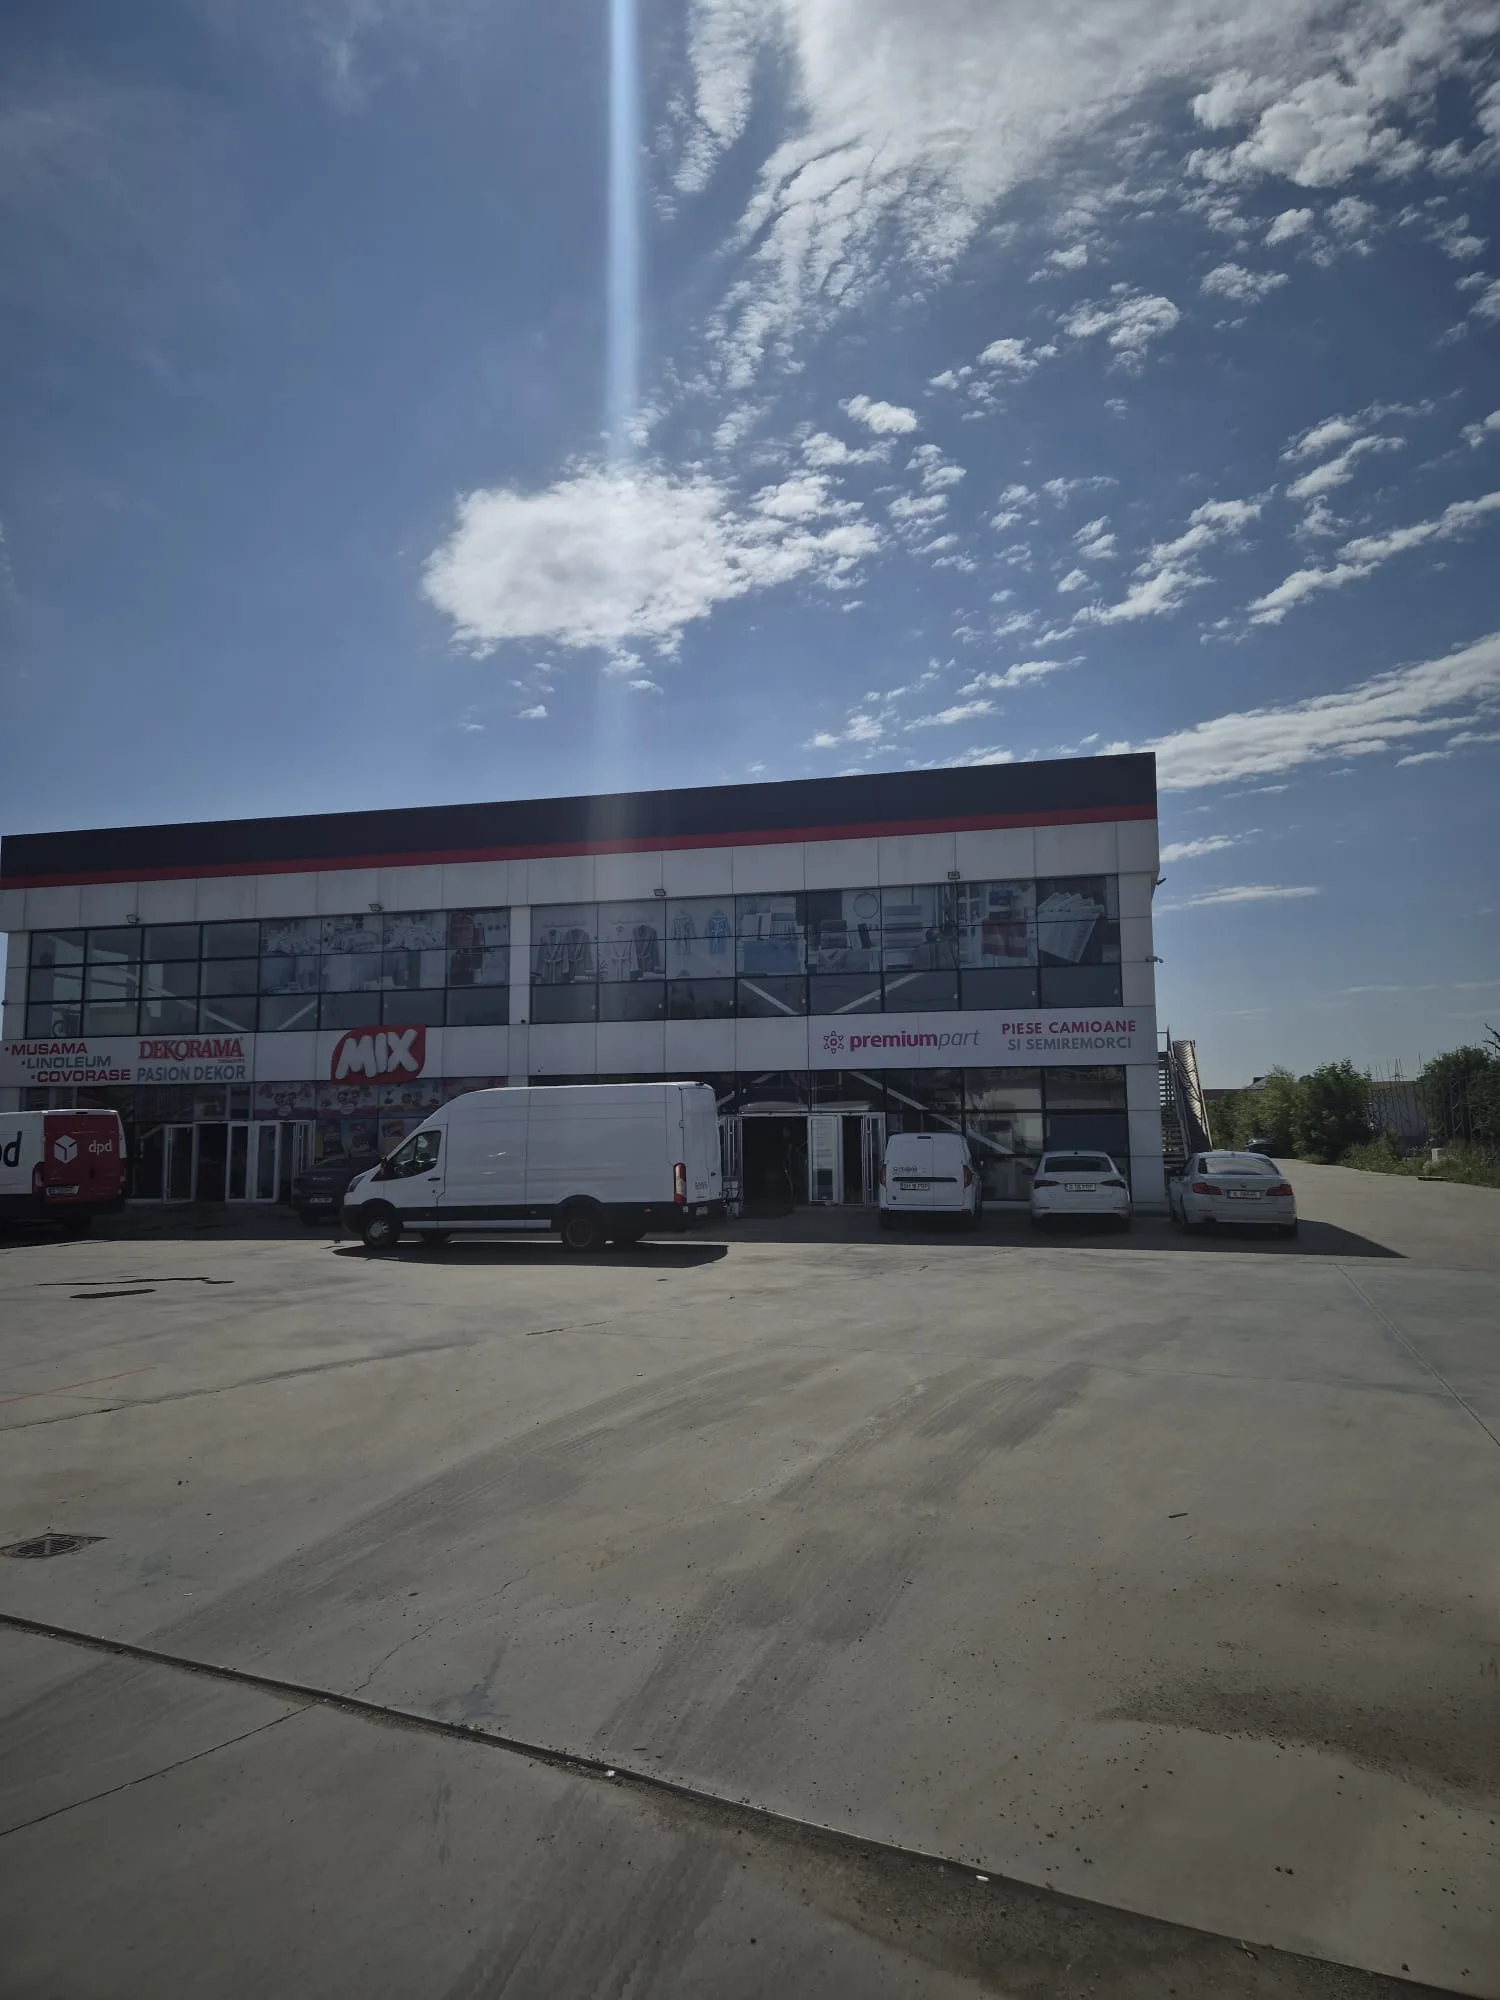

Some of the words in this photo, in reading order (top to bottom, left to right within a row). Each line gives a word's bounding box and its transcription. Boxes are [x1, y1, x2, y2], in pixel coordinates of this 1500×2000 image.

[1001, 1022, 1043, 1035] PIESE
[1048, 1020, 1136, 1034] CAMIOANE
[849, 1030, 980, 1051] premiumpart
[1007, 1038, 1021, 1051] SI
[1026, 1037, 1132, 1051] SEMIREMORCI
[11, 1042, 88, 1056] MUSAMA
[138, 1038, 244, 1061] DEKORAMA
[335, 1028, 419, 1080] MIX
[26, 1055, 112, 1069] LINOLEUM
[37, 1065, 131, 1082] COVORASE
[193, 1065, 245, 1080] DEKOR
[88, 1139, 113, 1155] dpd
